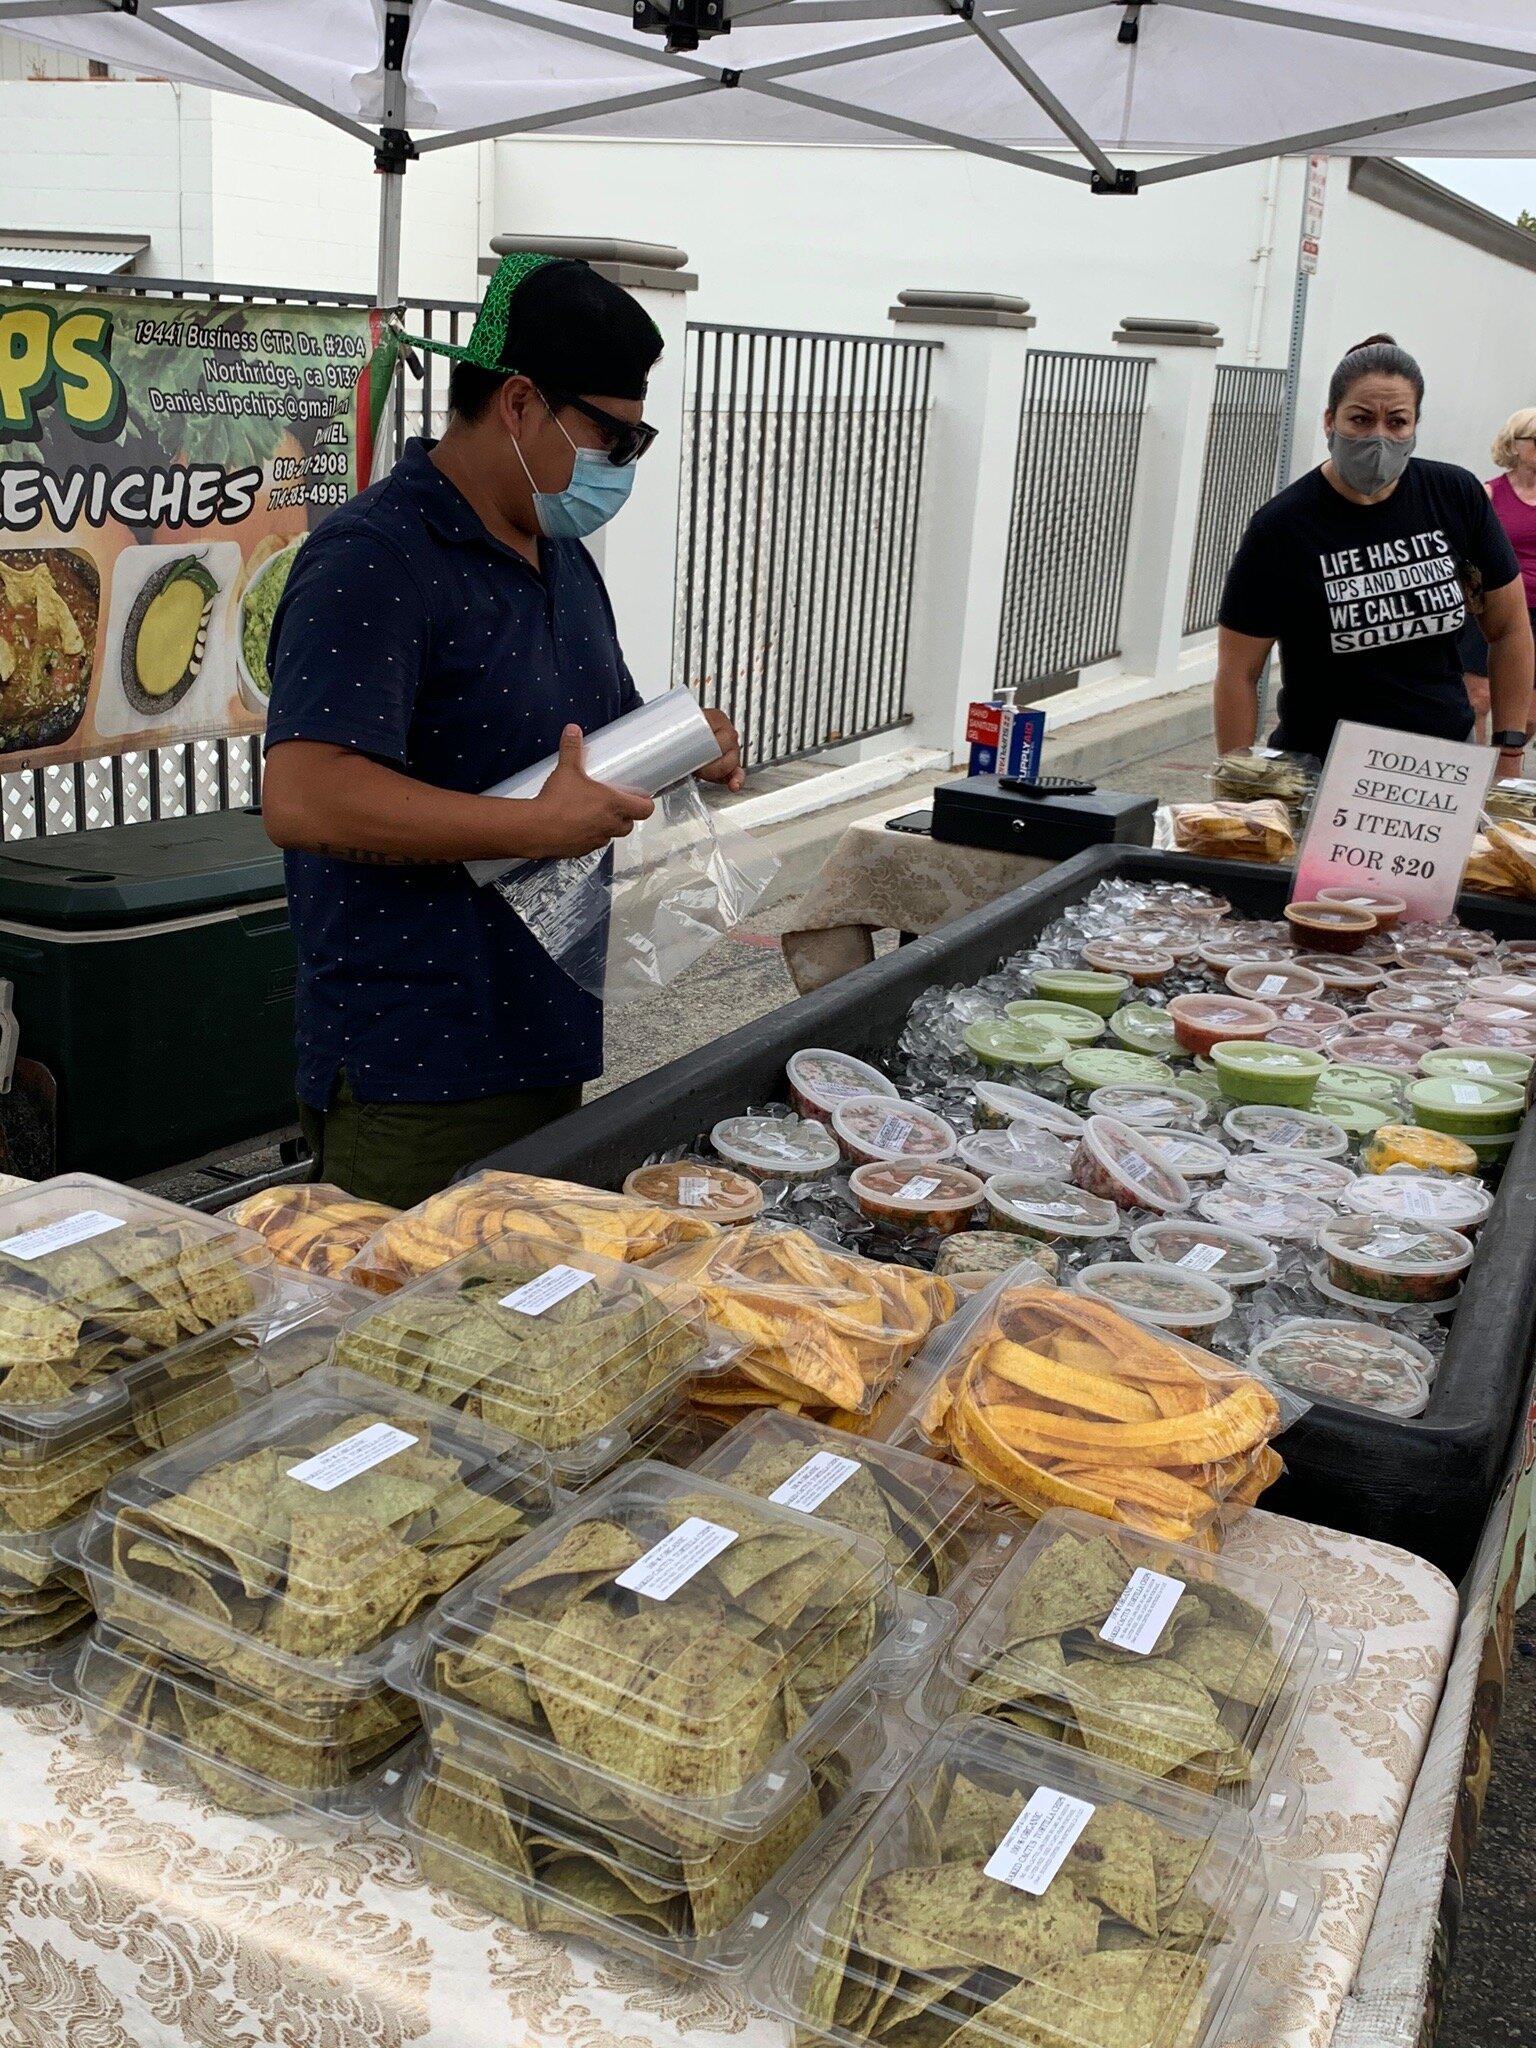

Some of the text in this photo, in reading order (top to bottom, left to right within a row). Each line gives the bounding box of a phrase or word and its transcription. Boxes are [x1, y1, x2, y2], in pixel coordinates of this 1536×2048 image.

[136, 321, 366, 358] 19441 Business CTR Dr. #204
[204, 358, 302, 388] Northridge,
[304, 368, 325, 386] ca
[313, 423, 348, 446] DNIEL
[0, 467, 261, 529] EVICHES
[1319, 529, 1449, 578] LIFE HAS IT'S
[1326, 558, 1455, 602] UPS AND DOWNS
[1330, 580, 1464, 630] WE CALL THEM
[1333, 607, 1464, 652] SQUATS
[1366, 750, 1470, 783] TODAY'S
[1354, 778, 1458, 812] SPECIAL
[1332, 808, 1442, 844] 5 ITEMS
[1328, 844, 1435, 880] FOR $20
